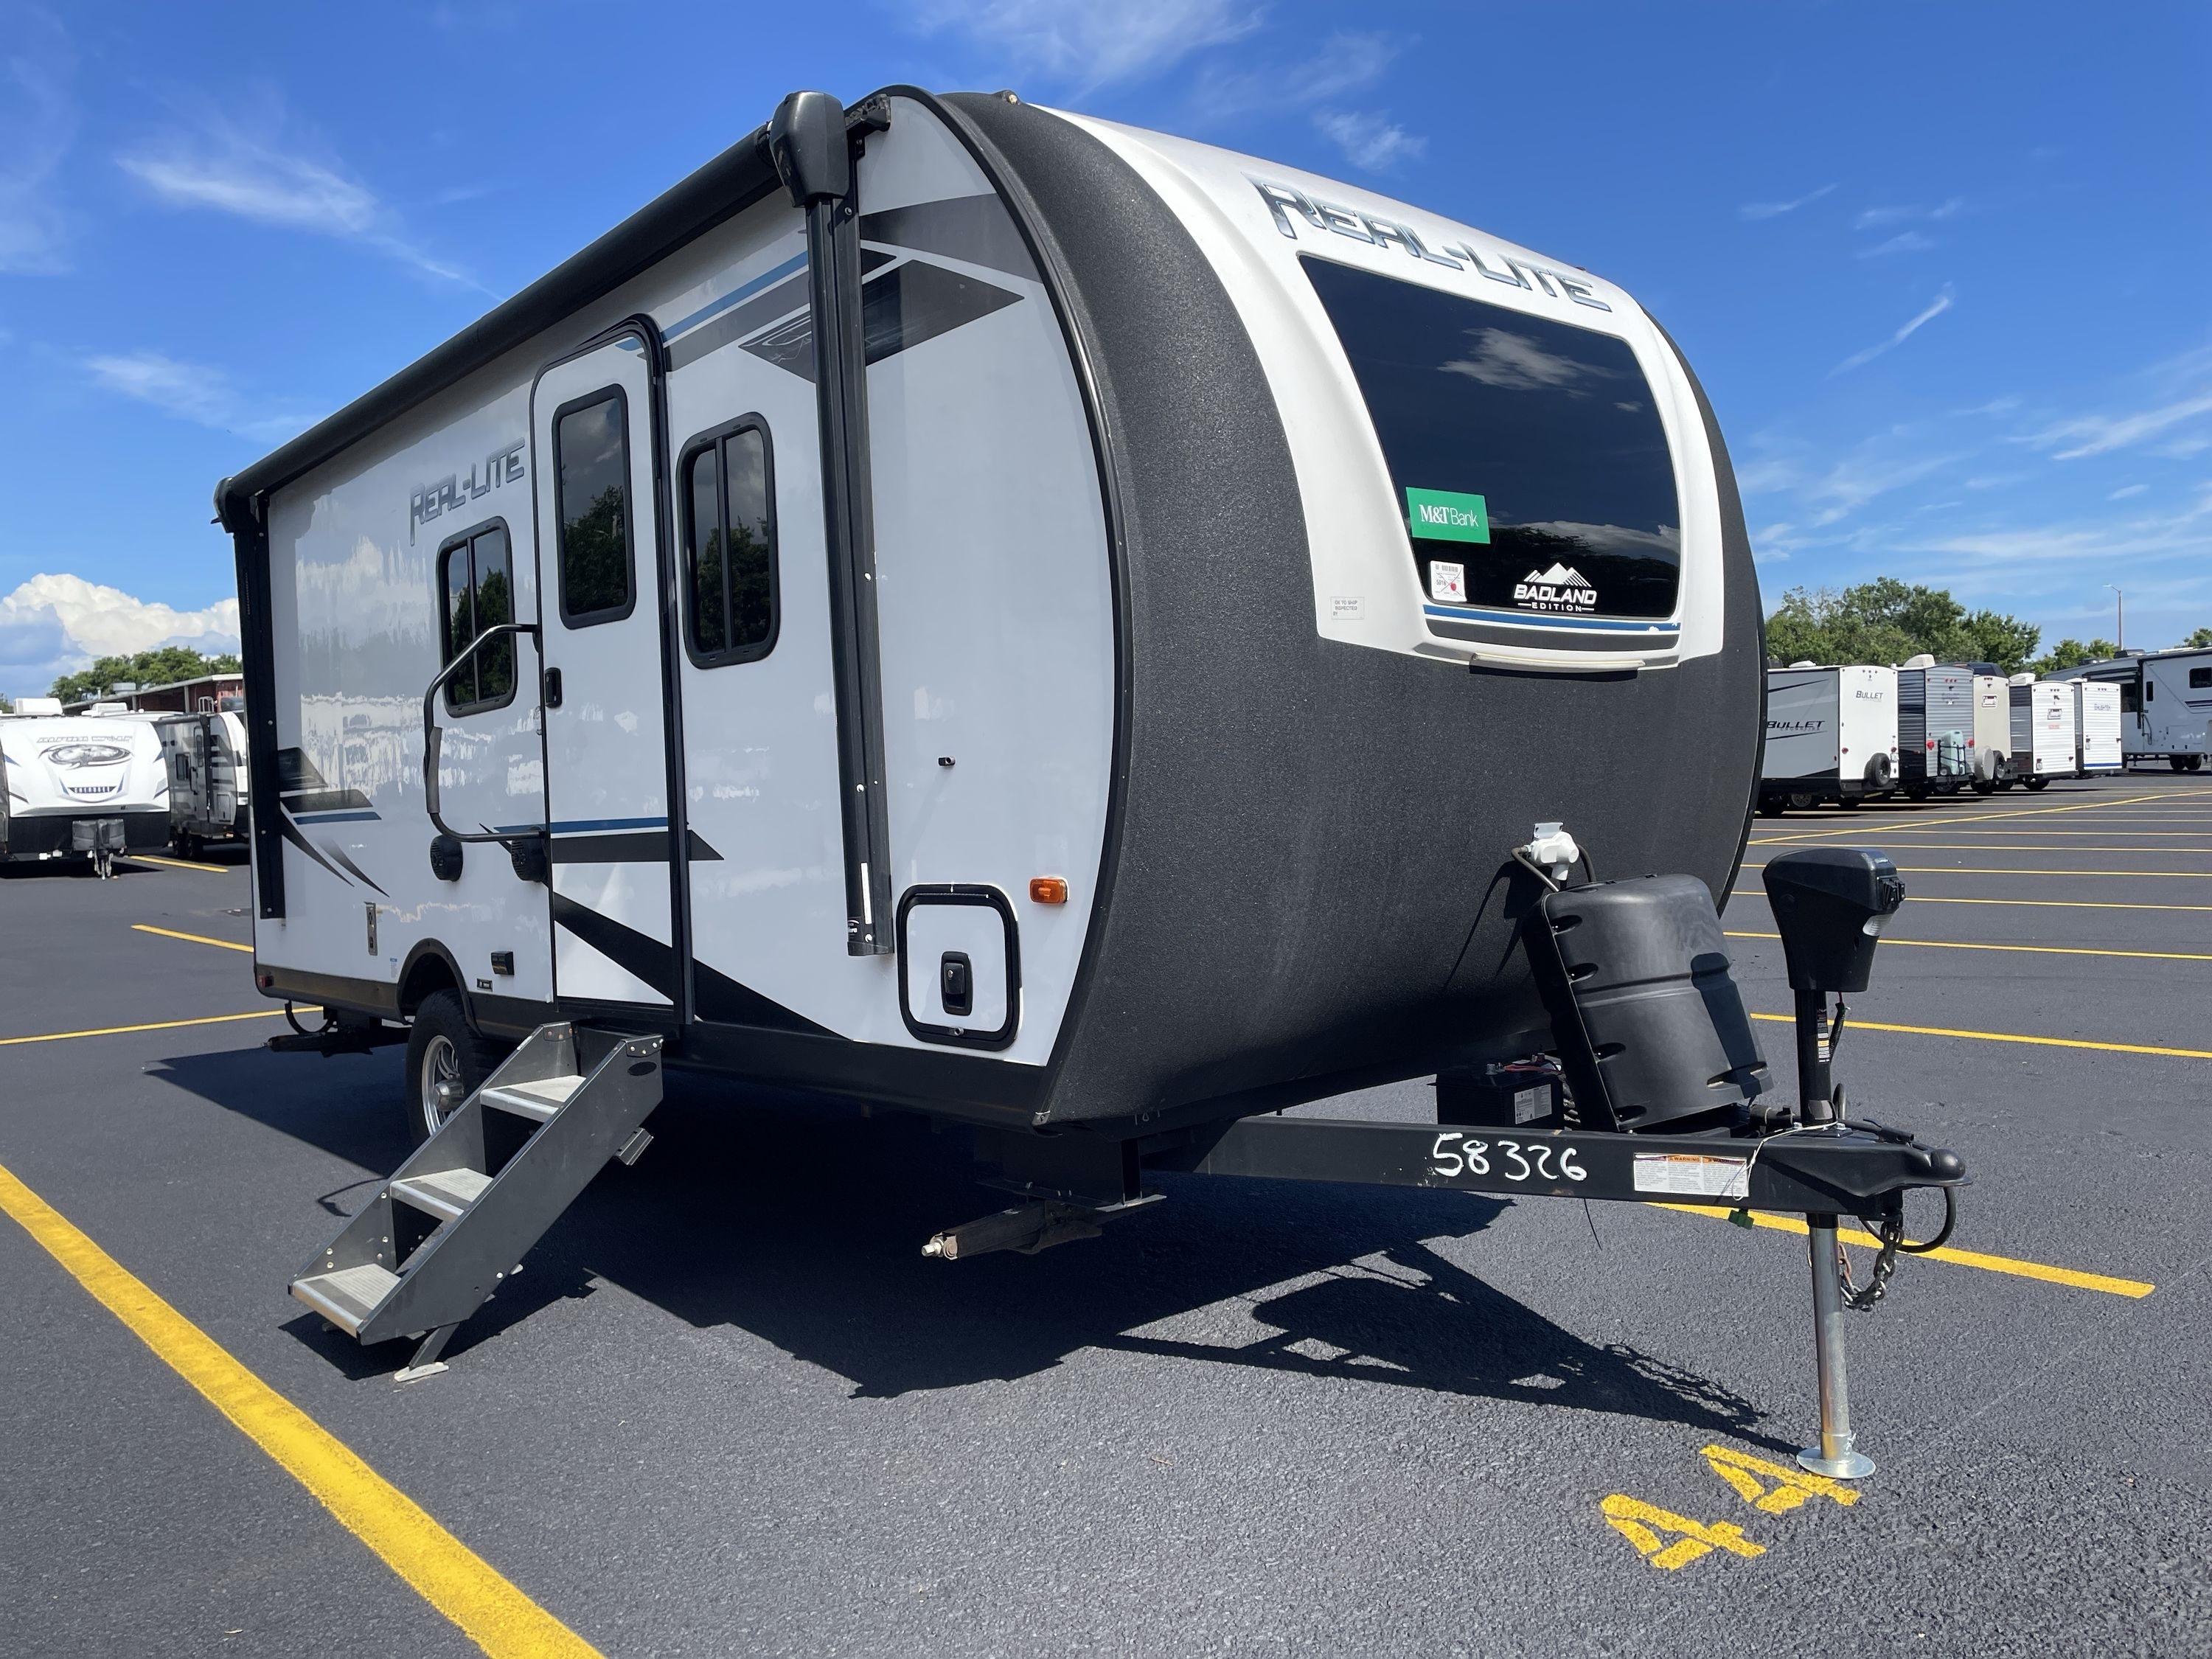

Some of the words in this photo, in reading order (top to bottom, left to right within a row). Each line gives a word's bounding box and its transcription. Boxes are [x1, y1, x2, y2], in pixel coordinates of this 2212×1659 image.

[1241, 172, 1613, 313] REAL-LITE
[409, 437, 526, 547] REAL-LITE
[1419, 504, 1450, 524] M&T
[1450, 507, 1479, 527] Bank
[1513, 583, 1597, 605] BADLAND
[1531, 602, 1582, 612] EDITION
[1855, 690, 1884, 700] BULLET
[1767, 720, 1826, 729] BULLET
[1433, 1132, 1587, 1181] 58326
